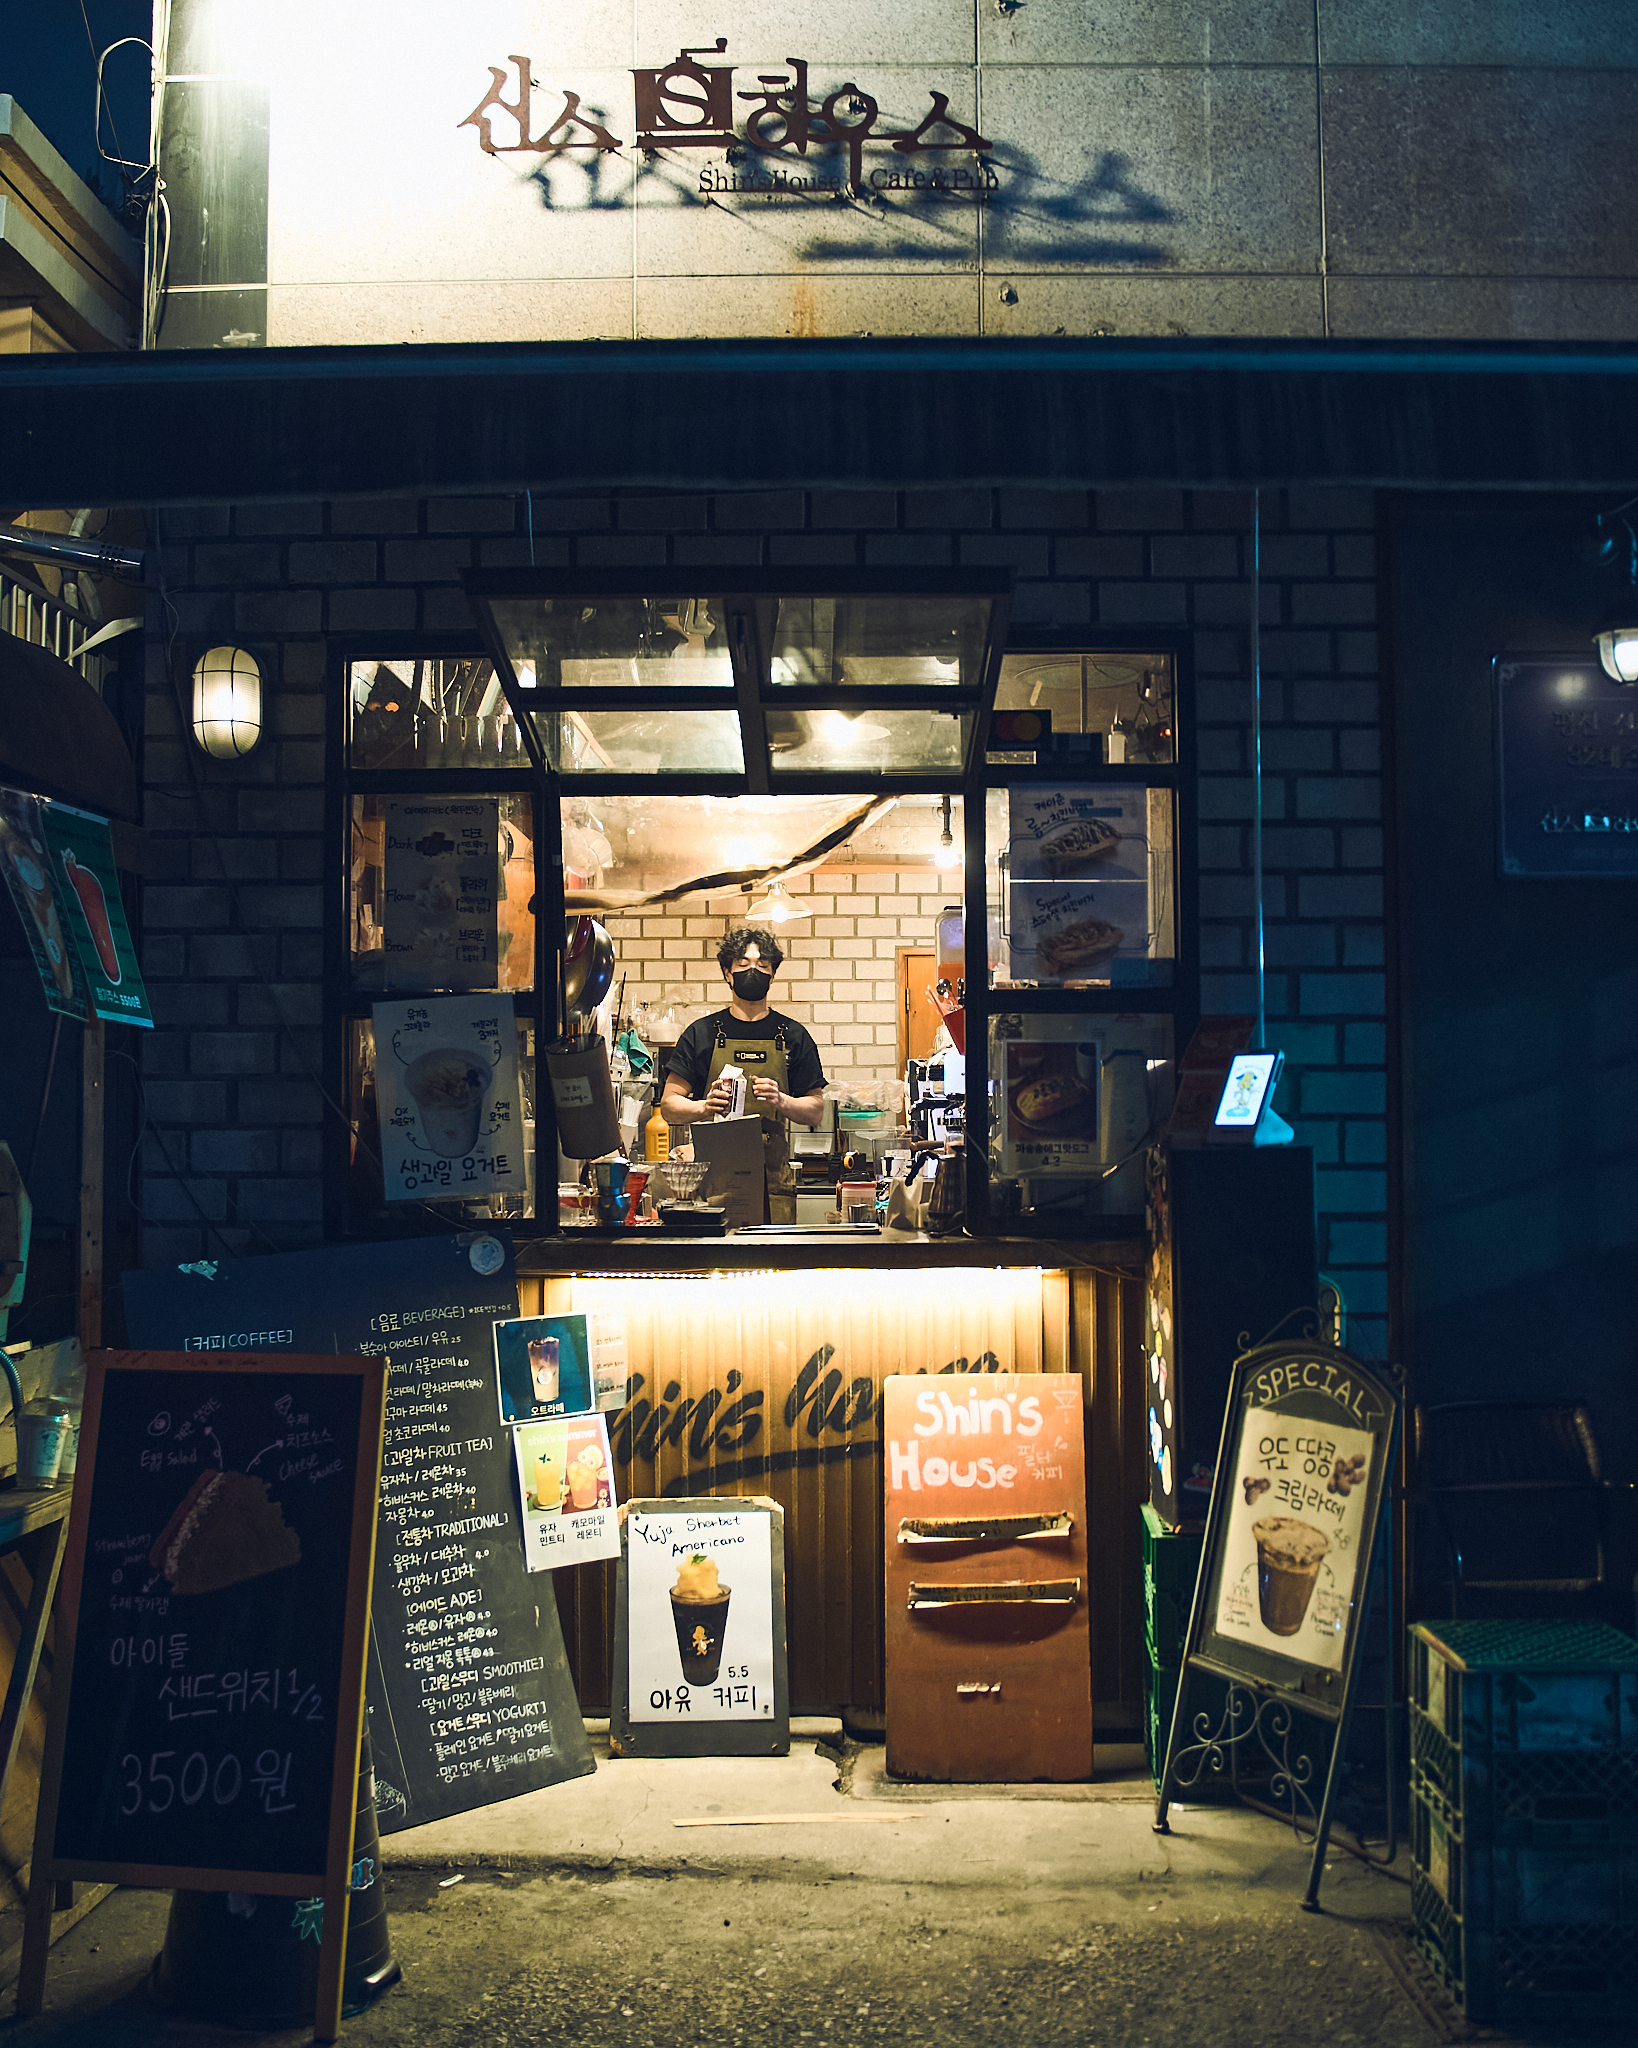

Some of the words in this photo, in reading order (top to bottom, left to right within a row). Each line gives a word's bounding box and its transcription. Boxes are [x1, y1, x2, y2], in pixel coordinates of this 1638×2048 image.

[699, 168, 767, 192] Shin's
[772, 169, 841, 192] House
[869, 167, 925, 191] Cafe
[931, 167, 949, 190] &
[952, 167, 999, 191] Pub
[388, 836, 414, 850] Dark
[384, 939, 414, 952] Brown
[489, 1110, 511, 1122] 요거트
[400, 1158, 451, 1190] 생과일
[461, 1154, 512, 1182] 요거트
[228, 1329, 293, 1348] COFFEE]
[431, 1330, 449, 1346] 우유
[415, 1356, 456, 1375] 곡물라떼
[1256, 1362, 1365, 1419] SPECIAL
[530, 1402, 565, 1417] 오트라떼
[913, 1386, 1044, 1437] Shin's
[394, 1421, 438, 1441] 초코라떼
[556, 1428, 598, 1443] summer
[428, 1441, 462, 1459] FRUIT
[1017, 1443, 1053, 1467] 필터
[1295, 1437, 1337, 1478] 땅콩
[140, 1450, 164, 1472] Egg
[889, 1439, 1018, 1491] House
[380, 1471, 413, 1490] 유자차
[421, 1463, 456, 1482] 레몬차
[1031, 1465, 1064, 1481] 커피
[383, 1489, 430, 1507] 히비스커스
[431, 1481, 465, 1499] 레몬차
[385, 1506, 421, 1526] 자몽차
[571, 1514, 606, 1529] 캐모마일
[539, 1522, 557, 1536] 유자
[576, 1527, 602, 1540] 레몬티
[634, 1524, 673, 1545] Yuja
[686, 1515, 741, 1532] Sherbet
[539, 1533, 565, 1547] 민트티
[671, 1534, 745, 1558] Americano
[431, 1543, 467, 1562] 대추차
[397, 1572, 433, 1597] 생강차
[441, 1562, 476, 1585] 모과차
[110, 1633, 190, 1669] 아이돌
[410, 1635, 457, 1655] 히비스커스
[412, 1655, 435, 1672] 리얼
[435, 1649, 455, 1669] 자몽
[728, 1665, 749, 1679] 5.5
[158, 1668, 280, 1722] 샌드위치
[649, 1685, 691, 1714] 아유
[712, 1685, 757, 1711] 커피
[467, 1731, 496, 1751] 요거트
